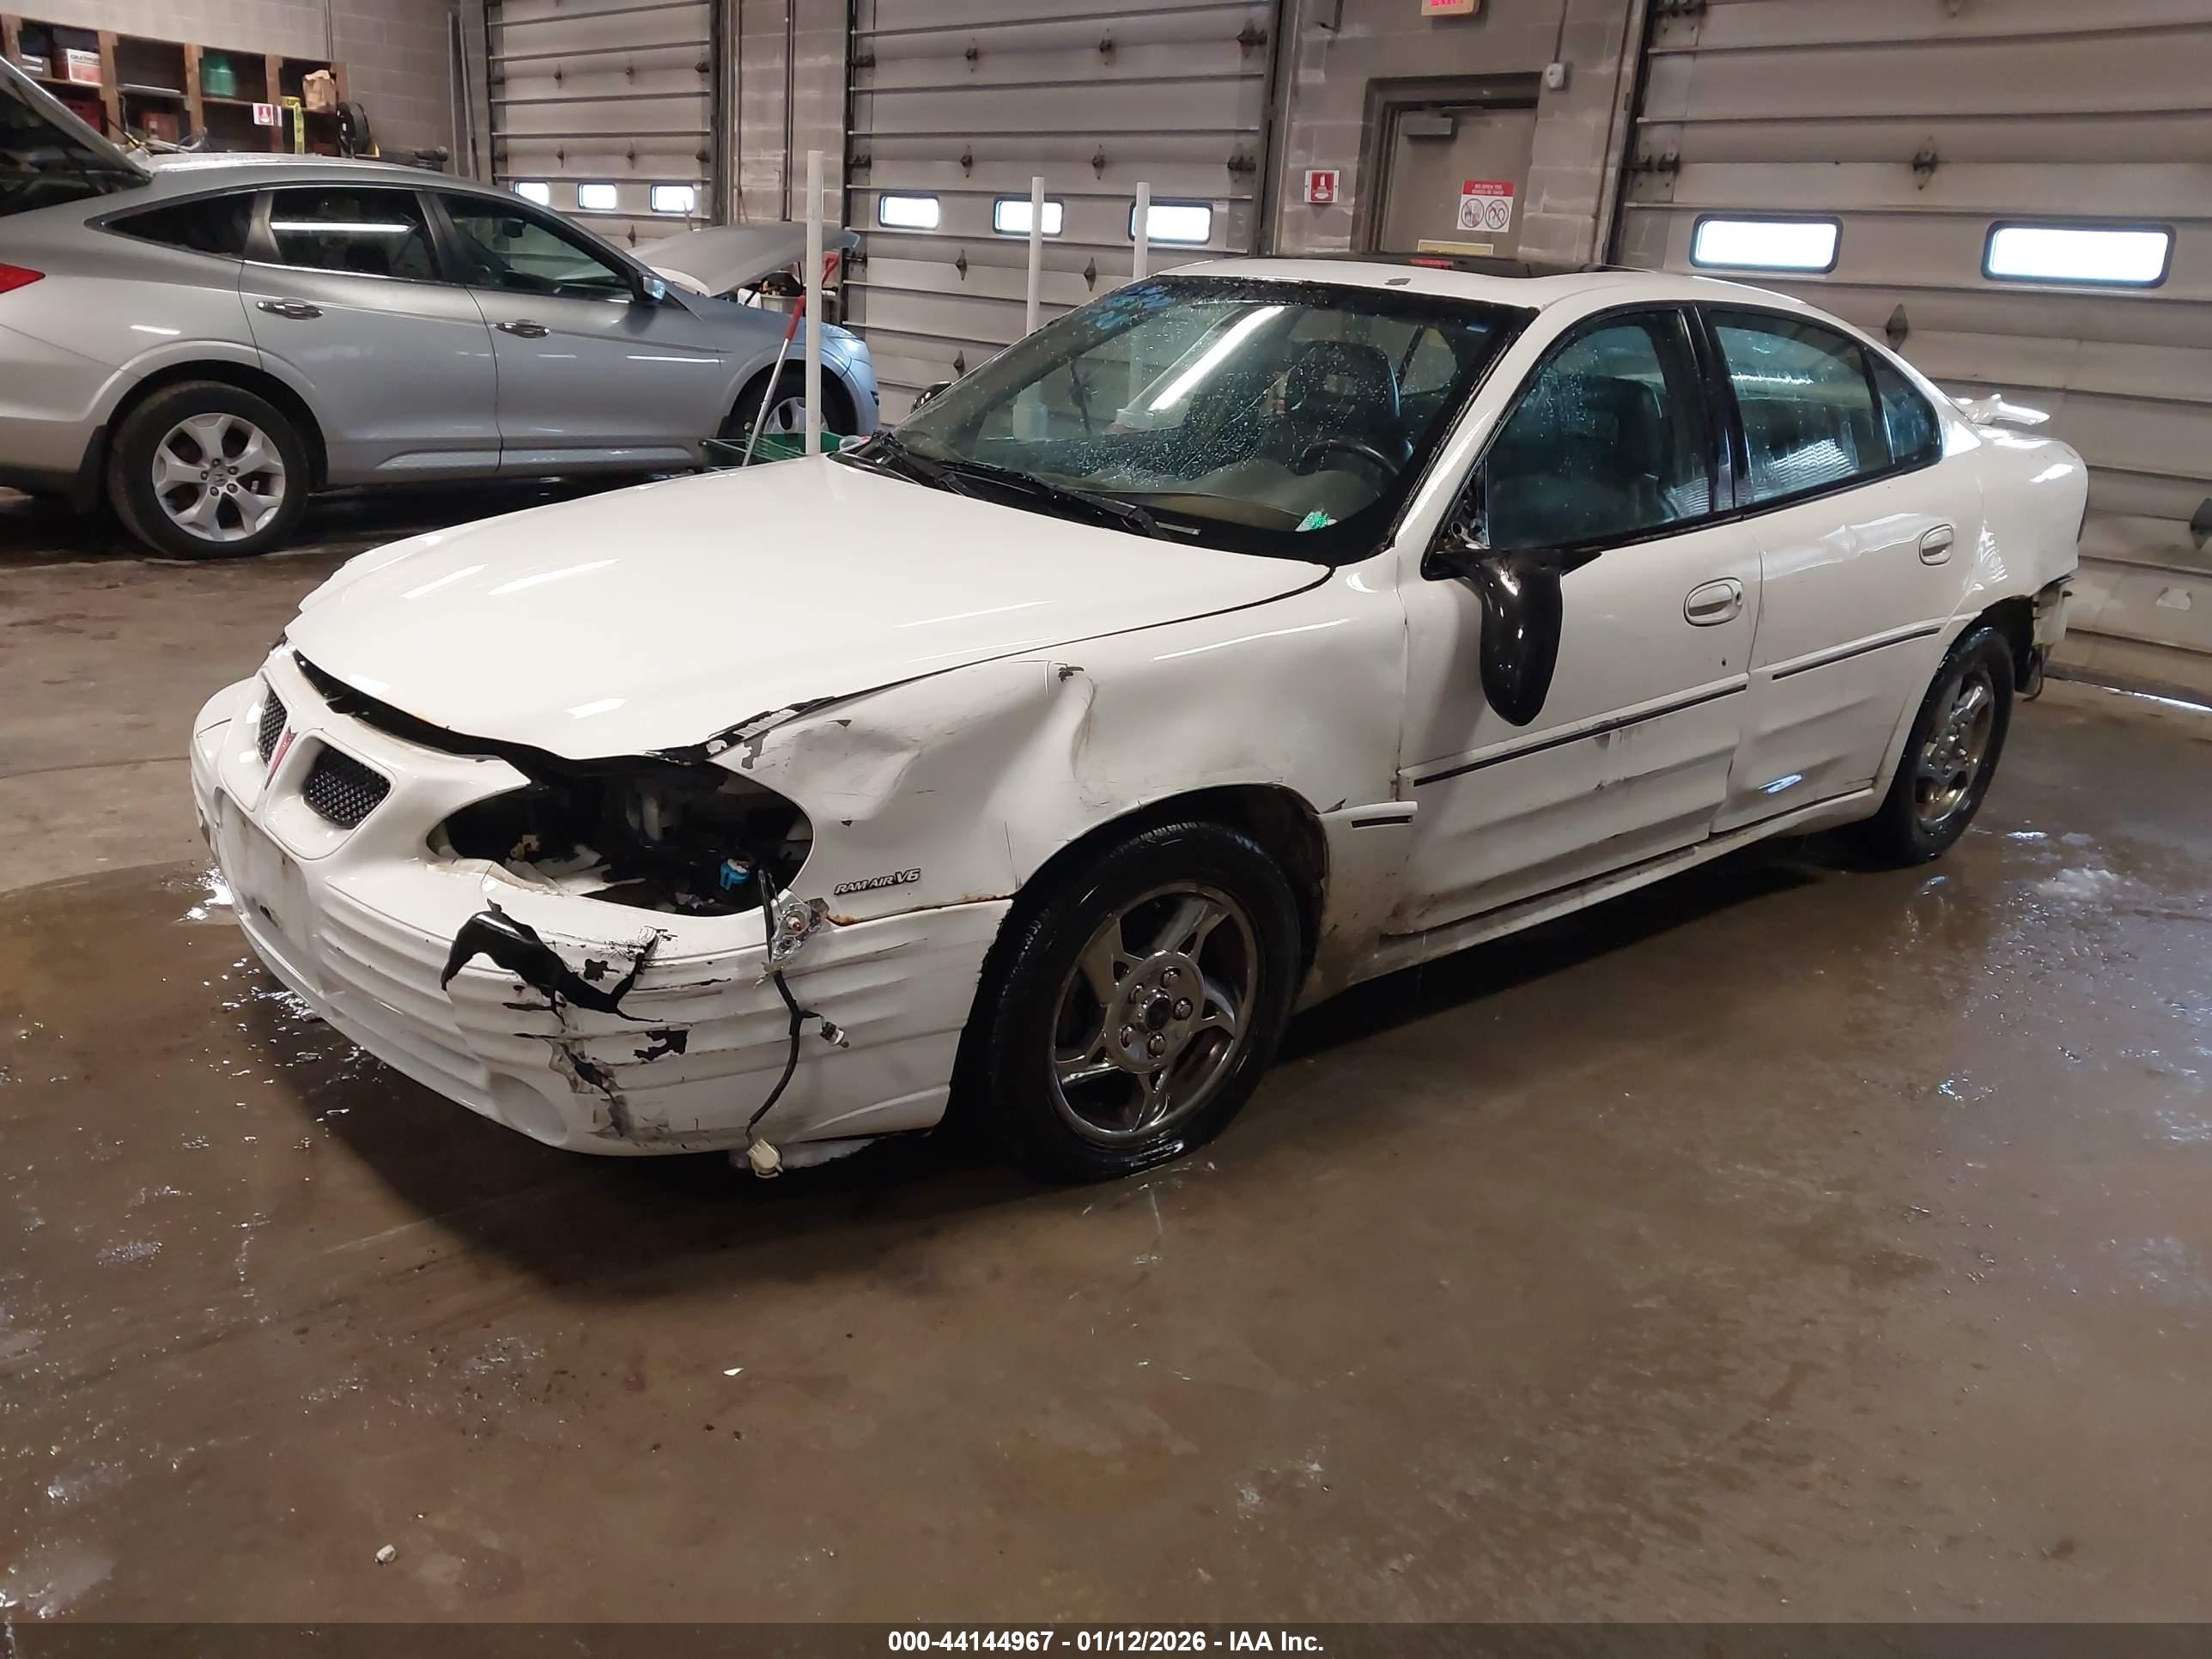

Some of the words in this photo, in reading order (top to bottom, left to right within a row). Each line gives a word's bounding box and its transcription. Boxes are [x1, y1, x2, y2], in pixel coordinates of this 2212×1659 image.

[834, 880, 867, 895] RAM
[867, 875, 895, 888] AIR
[895, 868, 921, 884] V6
